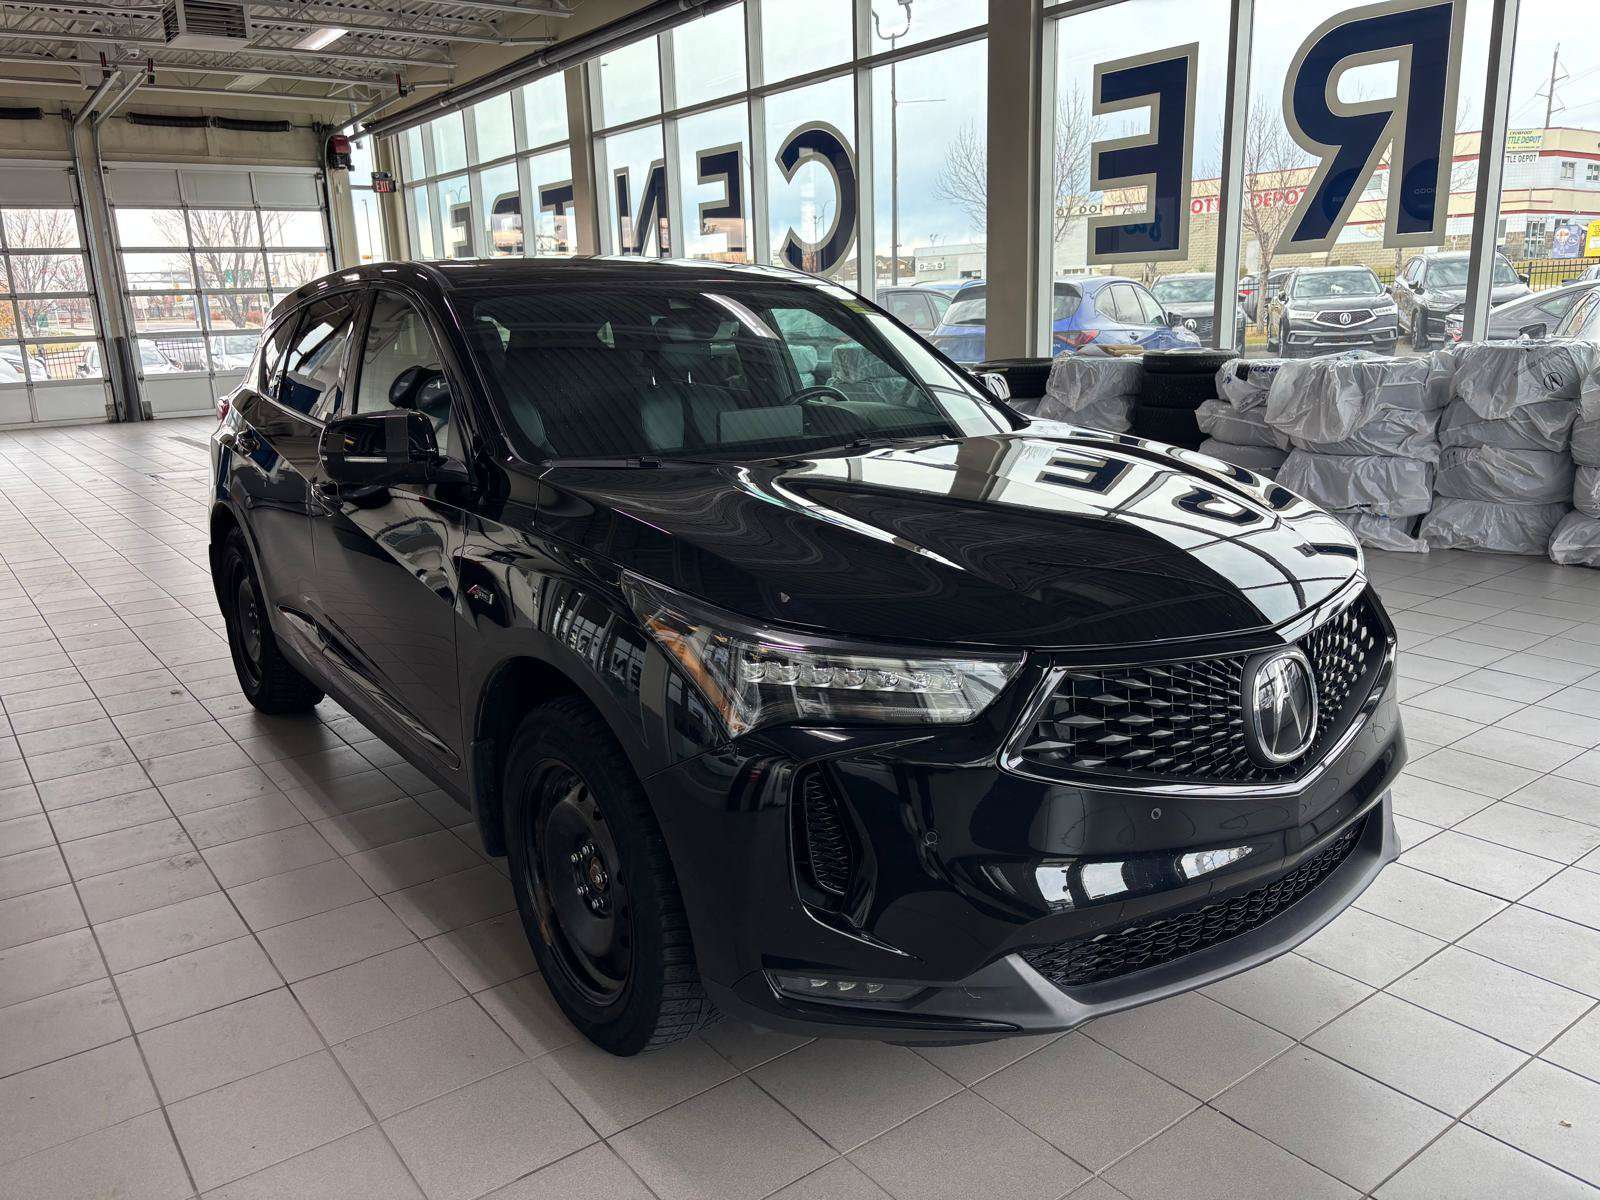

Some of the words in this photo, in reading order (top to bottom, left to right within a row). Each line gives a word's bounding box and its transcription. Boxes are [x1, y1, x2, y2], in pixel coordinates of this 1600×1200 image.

[1507, 136, 1521, 145] TTLE
[1521, 135, 1542, 144] DEPOT
[1507, 155, 1517, 163] TLE
[1518, 154, 1537, 163] DEPOT
[376, 180, 390, 192] EXIT
[1191, 197, 1220, 214] OTT
